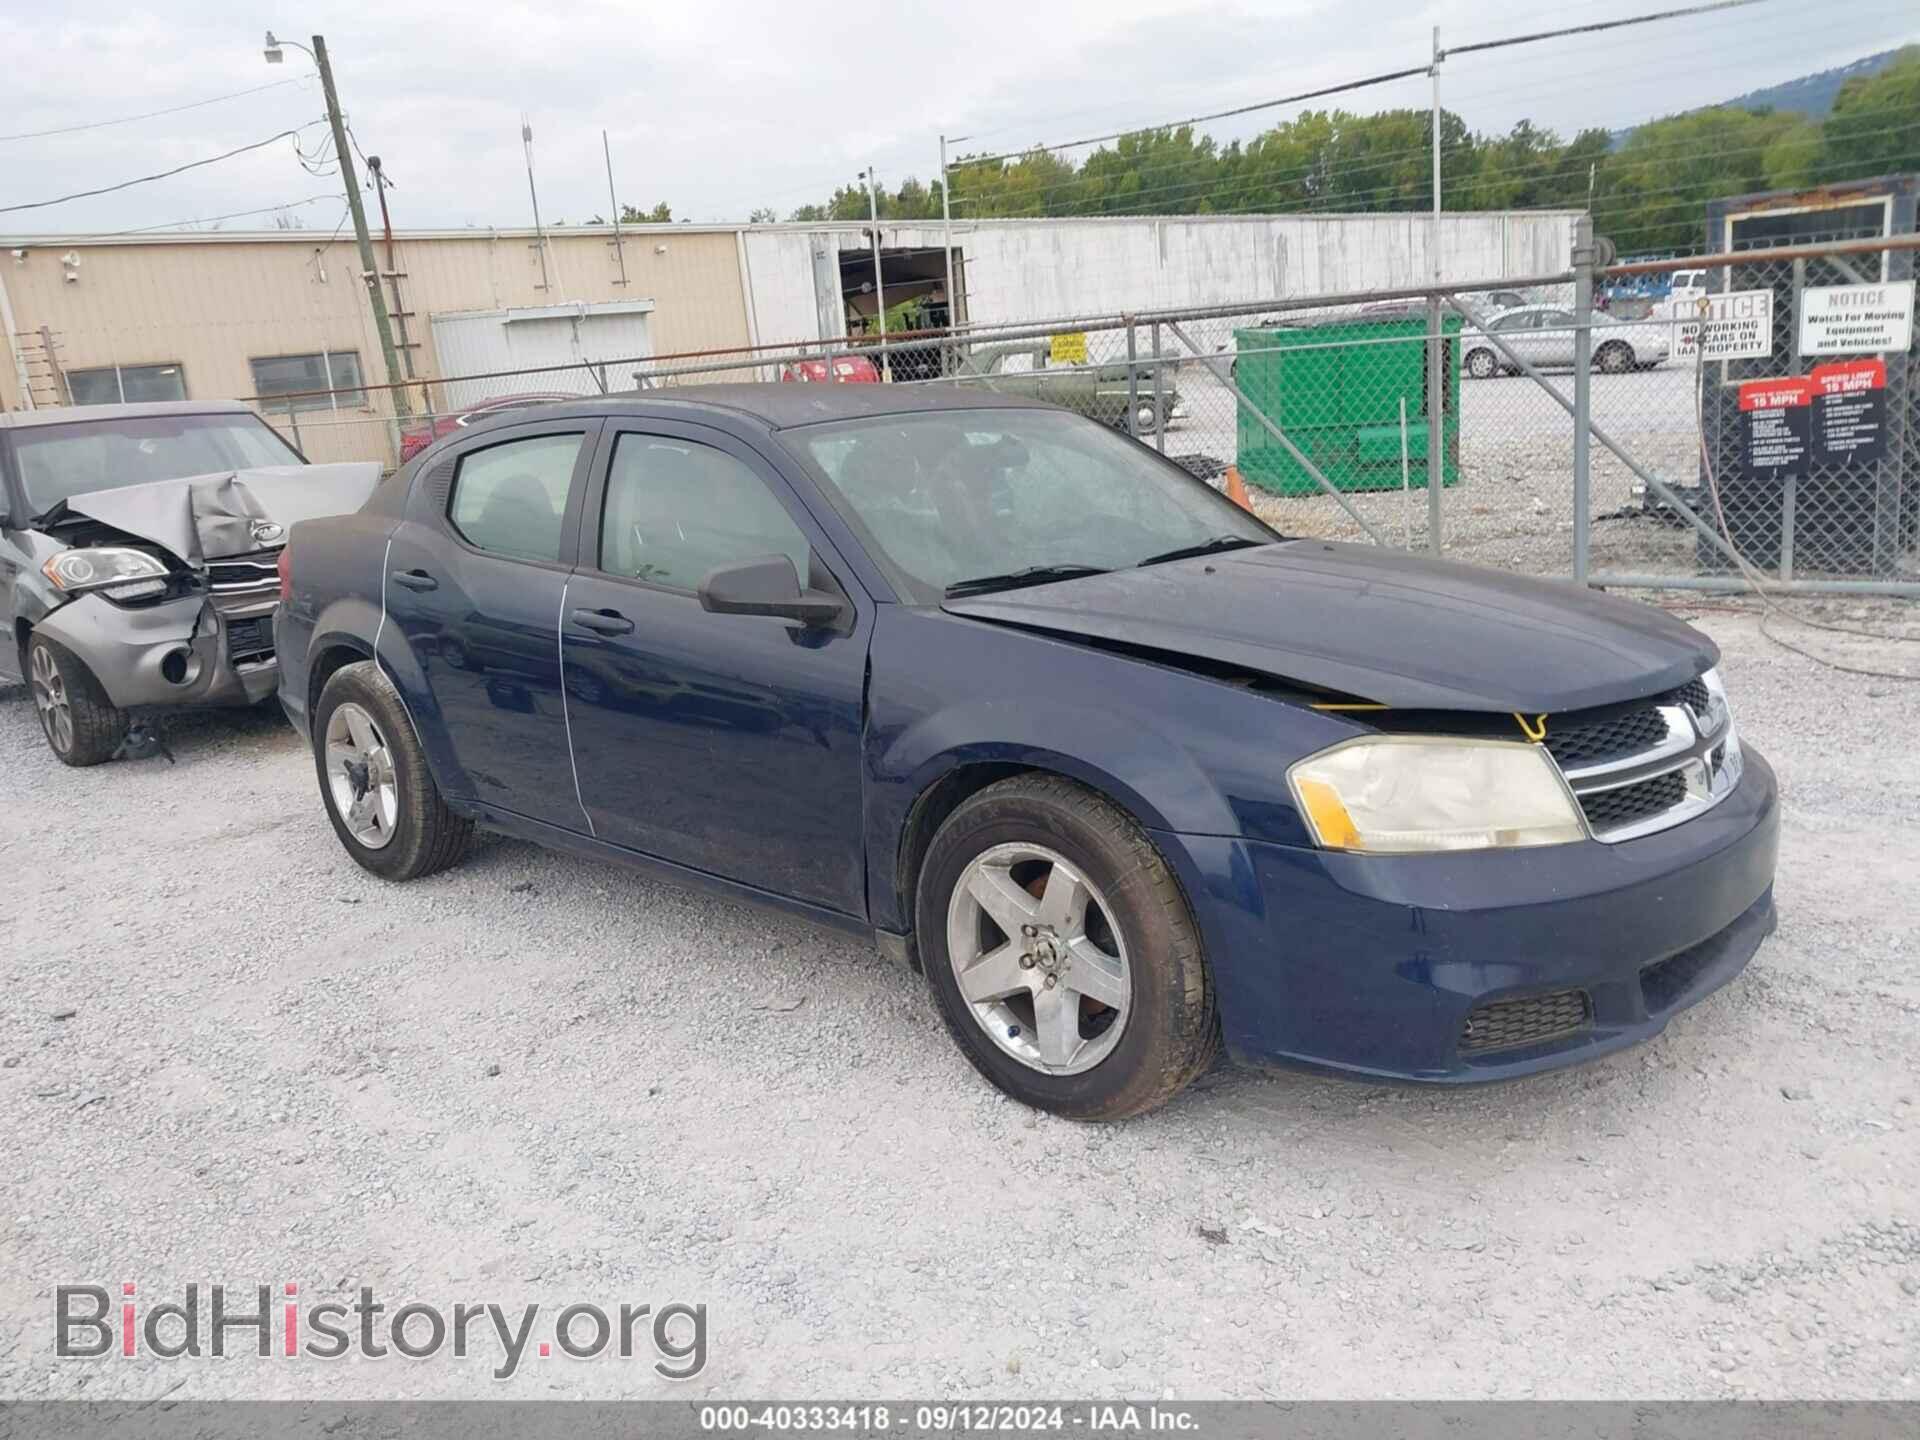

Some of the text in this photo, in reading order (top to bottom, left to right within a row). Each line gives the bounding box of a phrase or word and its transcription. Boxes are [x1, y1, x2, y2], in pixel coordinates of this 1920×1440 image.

[1829, 290, 1886, 307] NOTICE
[1808, 314, 1842, 324] Watch
[1865, 311, 1905, 321] Moving
[1682, 320, 1759, 335] NO WORKING
[1826, 325, 1884, 335] Equipment
[1704, 333, 1735, 343] CARS
[1740, 331, 1756, 340] ON
[1817, 336, 1892, 348] and Vehicles!
[1677, 346, 1696, 355] IAA
[1842, 379, 1872, 391] MPH
[1770, 393, 1798, 405] MPH
